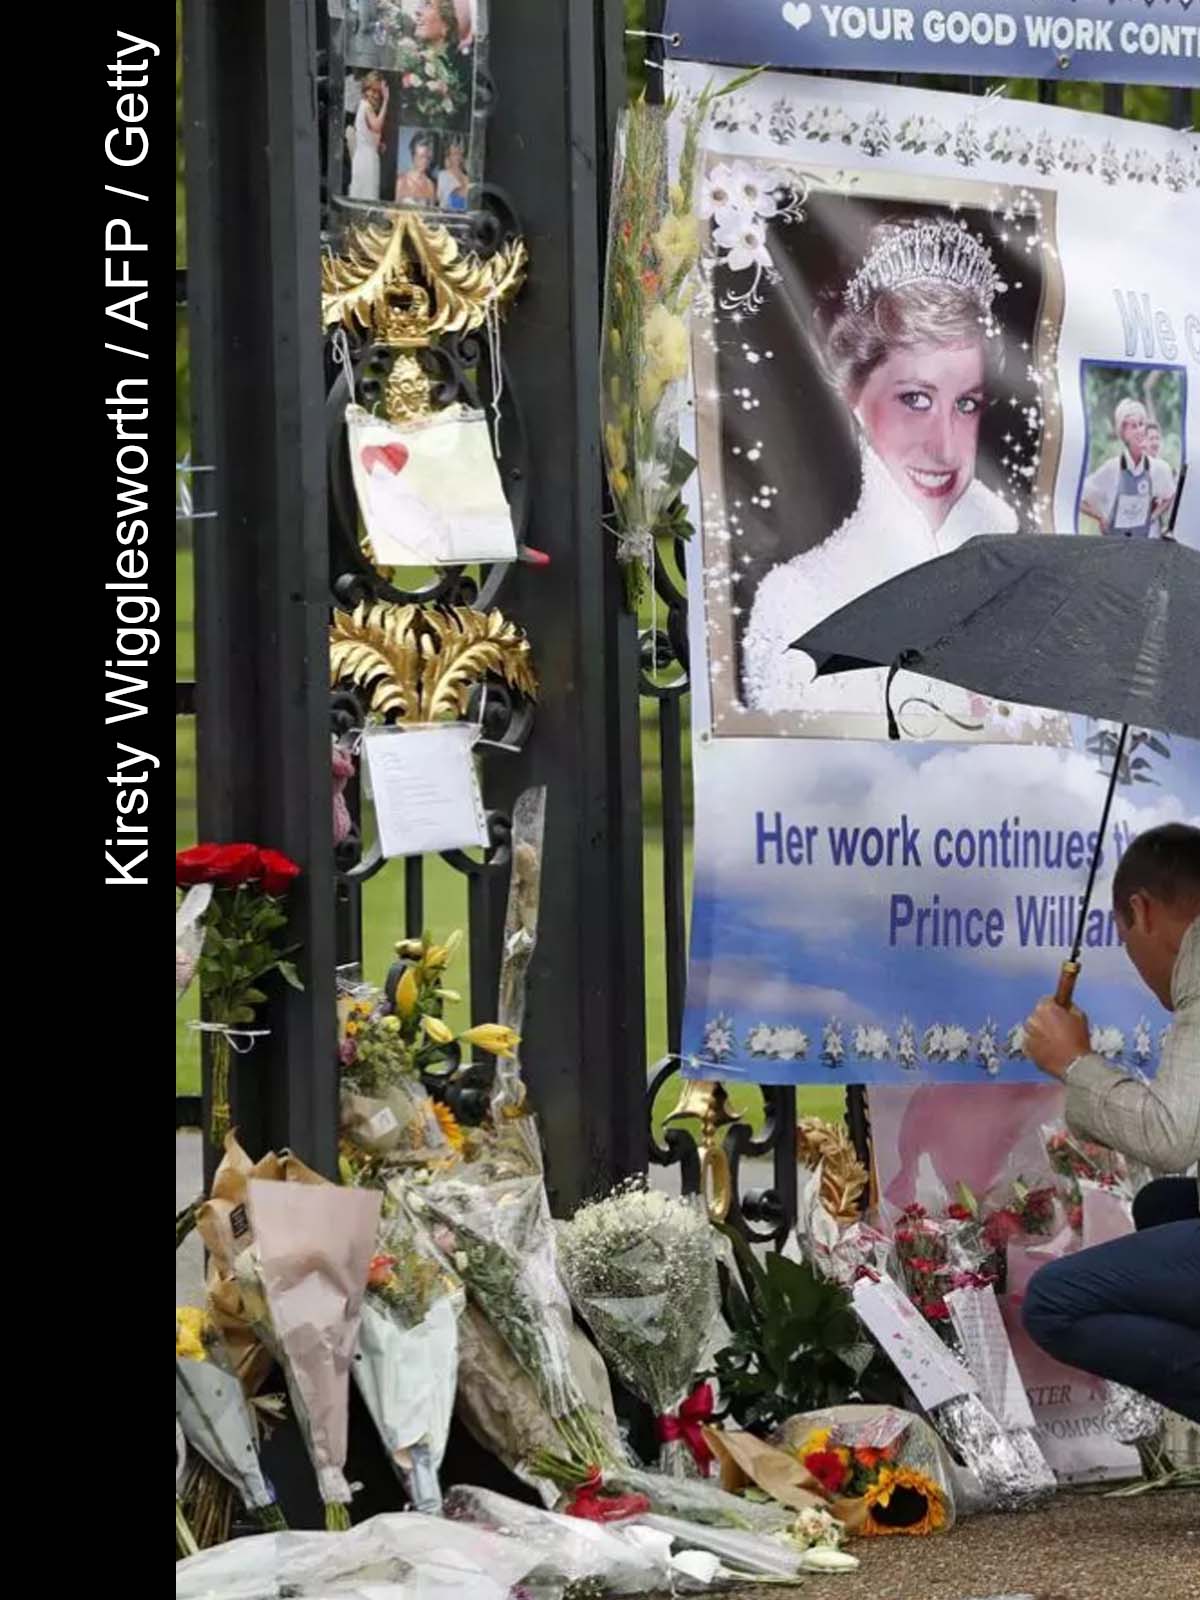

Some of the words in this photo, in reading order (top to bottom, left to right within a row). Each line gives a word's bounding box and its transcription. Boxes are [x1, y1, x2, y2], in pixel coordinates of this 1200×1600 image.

[822, 5, 913, 40] YOUR
[923, 10, 1017, 47] GOOD
[1025, 16, 1112, 53] WORK
[1112, 288, 1179, 362] We
[755, 811, 819, 866] Her
[827, 814, 922, 867] work
[933, 815, 1105, 869] continues
[889, 893, 1005, 948] Prince
